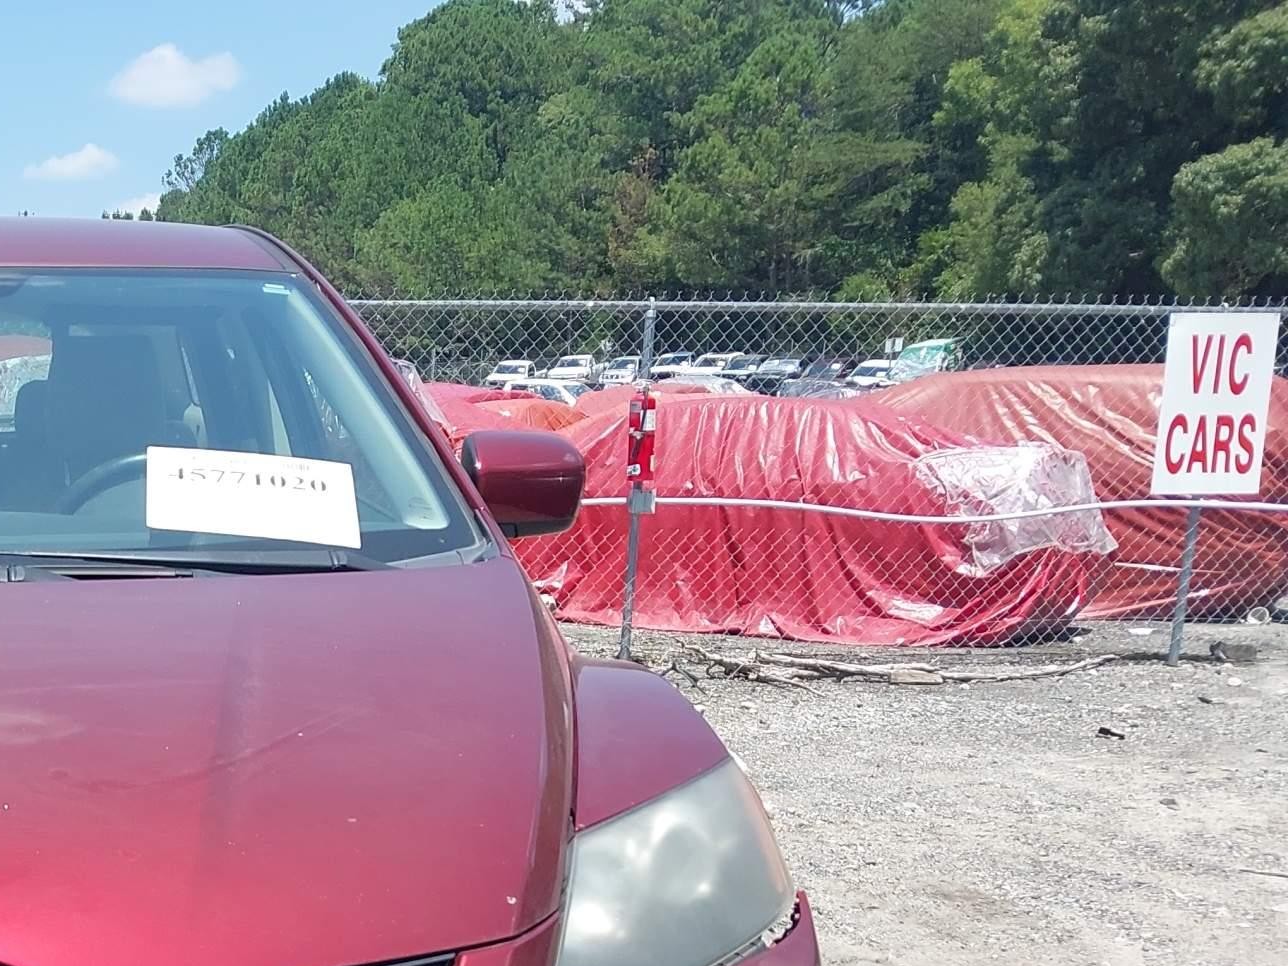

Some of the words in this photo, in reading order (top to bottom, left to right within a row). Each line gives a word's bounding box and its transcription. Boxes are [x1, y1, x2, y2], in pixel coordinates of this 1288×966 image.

[1192, 333, 1253, 395] VIC
[1165, 413, 1256, 474] CARS
[168, 467, 327, 493] 45771020
